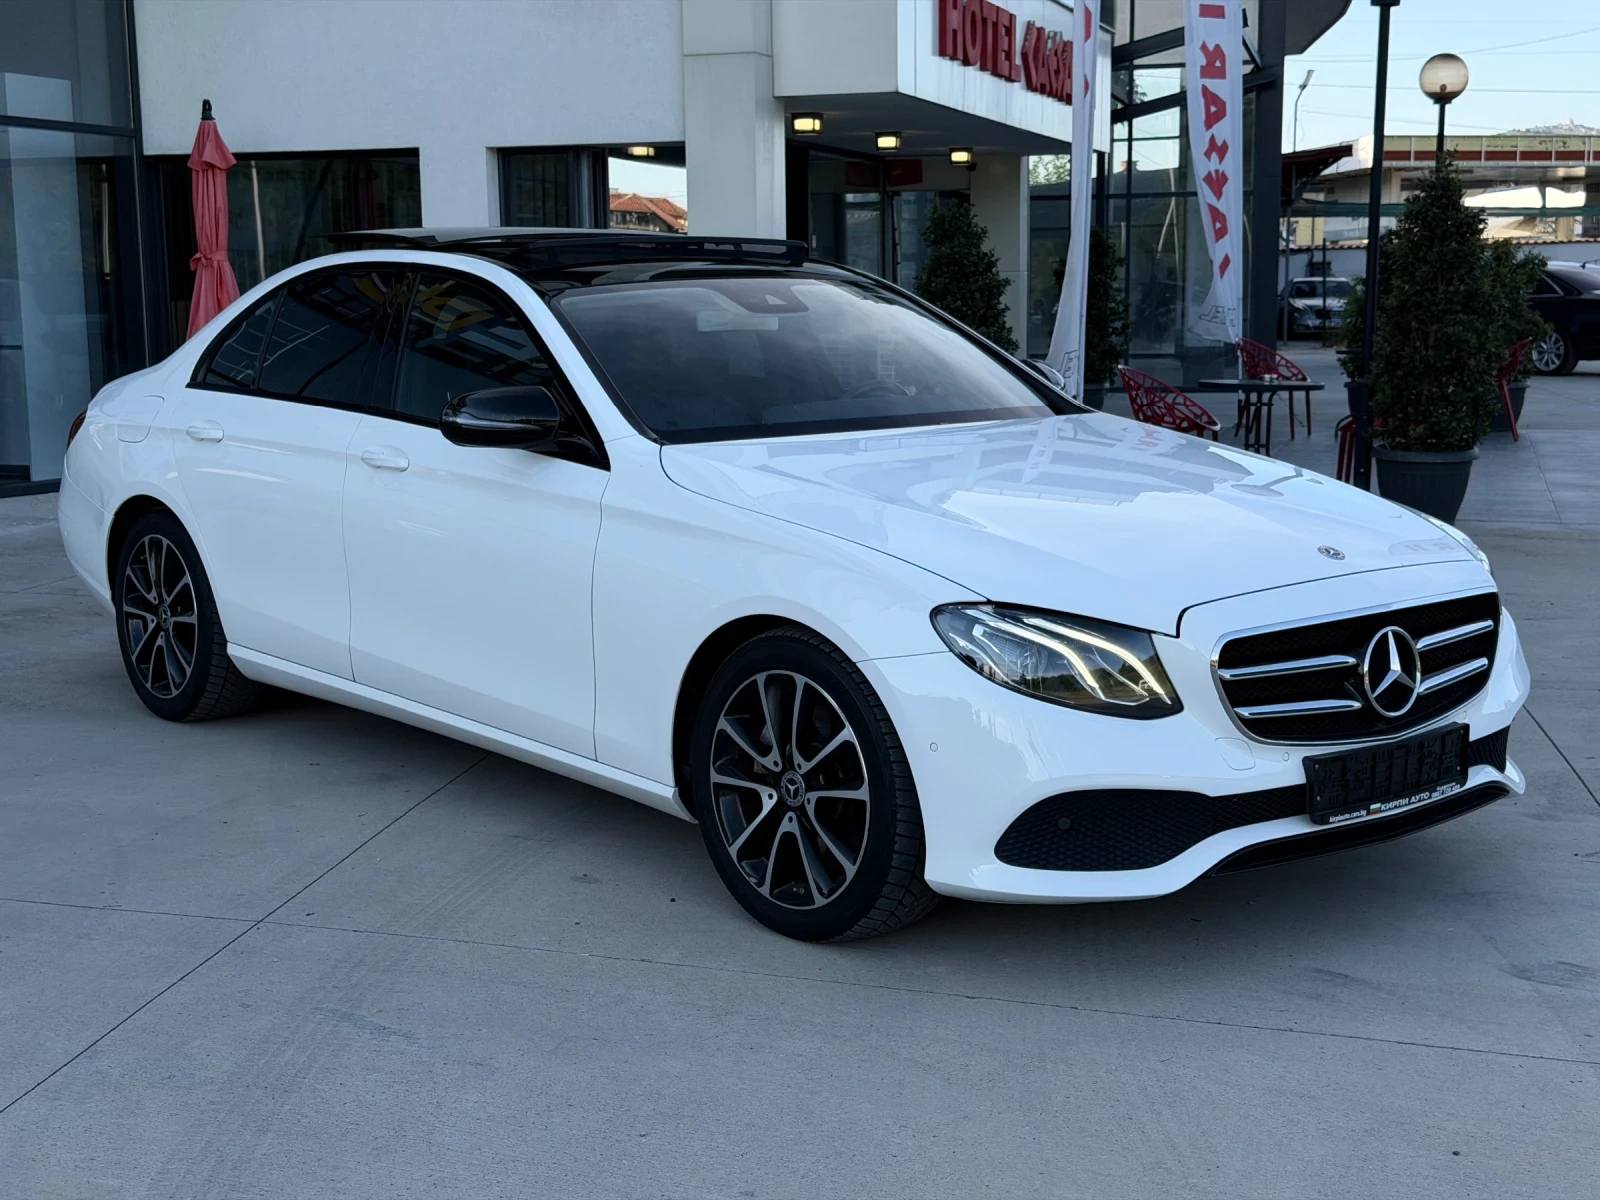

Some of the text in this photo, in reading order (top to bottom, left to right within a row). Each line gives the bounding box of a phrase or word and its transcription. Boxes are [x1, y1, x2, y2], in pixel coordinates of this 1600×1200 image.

[939, 0, 1021, 83] HOTEL
[1021, 20, 1073, 105] CAESA
[1380, 792, 1430, 811] КИРПИ АУТО
